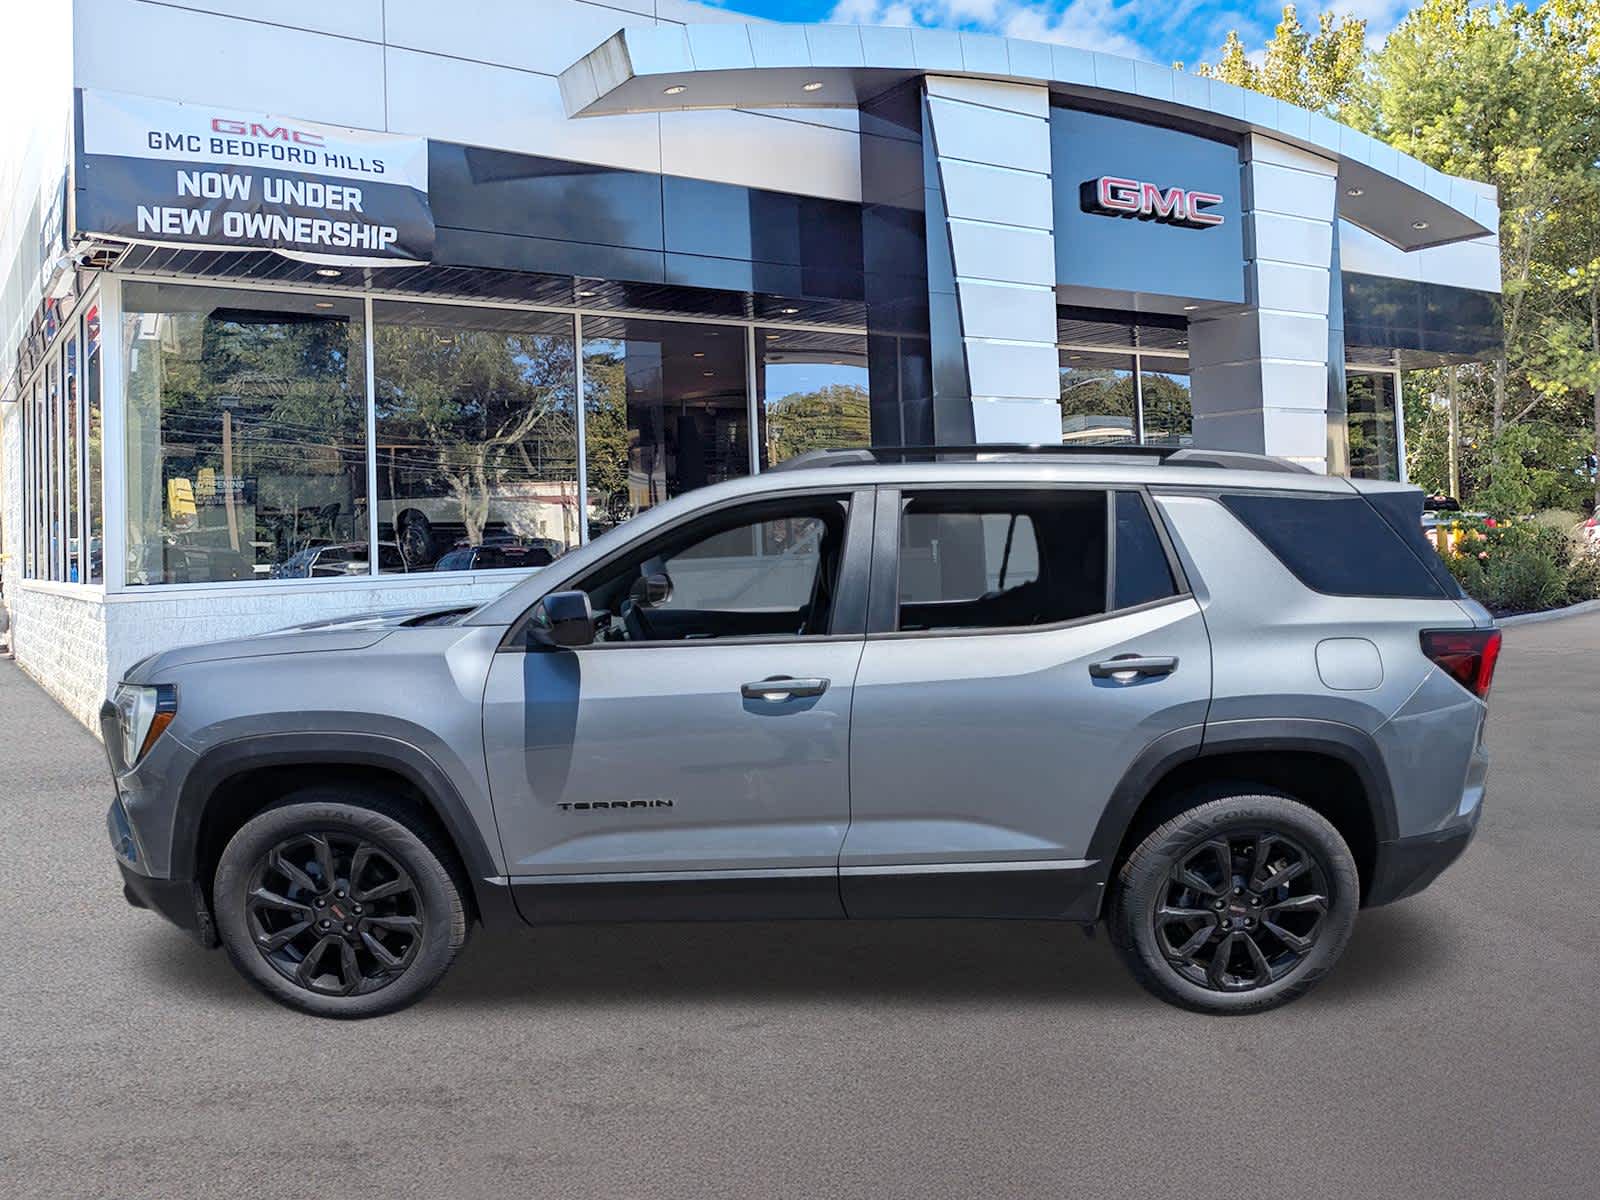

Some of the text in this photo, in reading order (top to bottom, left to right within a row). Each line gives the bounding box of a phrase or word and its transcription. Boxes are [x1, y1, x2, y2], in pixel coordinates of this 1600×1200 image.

[148, 131, 385, 174] GMC BEDFORD HILLS
[210, 118, 326, 148] GMC
[177, 170, 364, 213] NOW UNDER
[1097, 175, 1225, 225] GMC
[136, 205, 398, 250] NEW OWNERSHIP
[556, 799, 674, 811] TERRAIN
